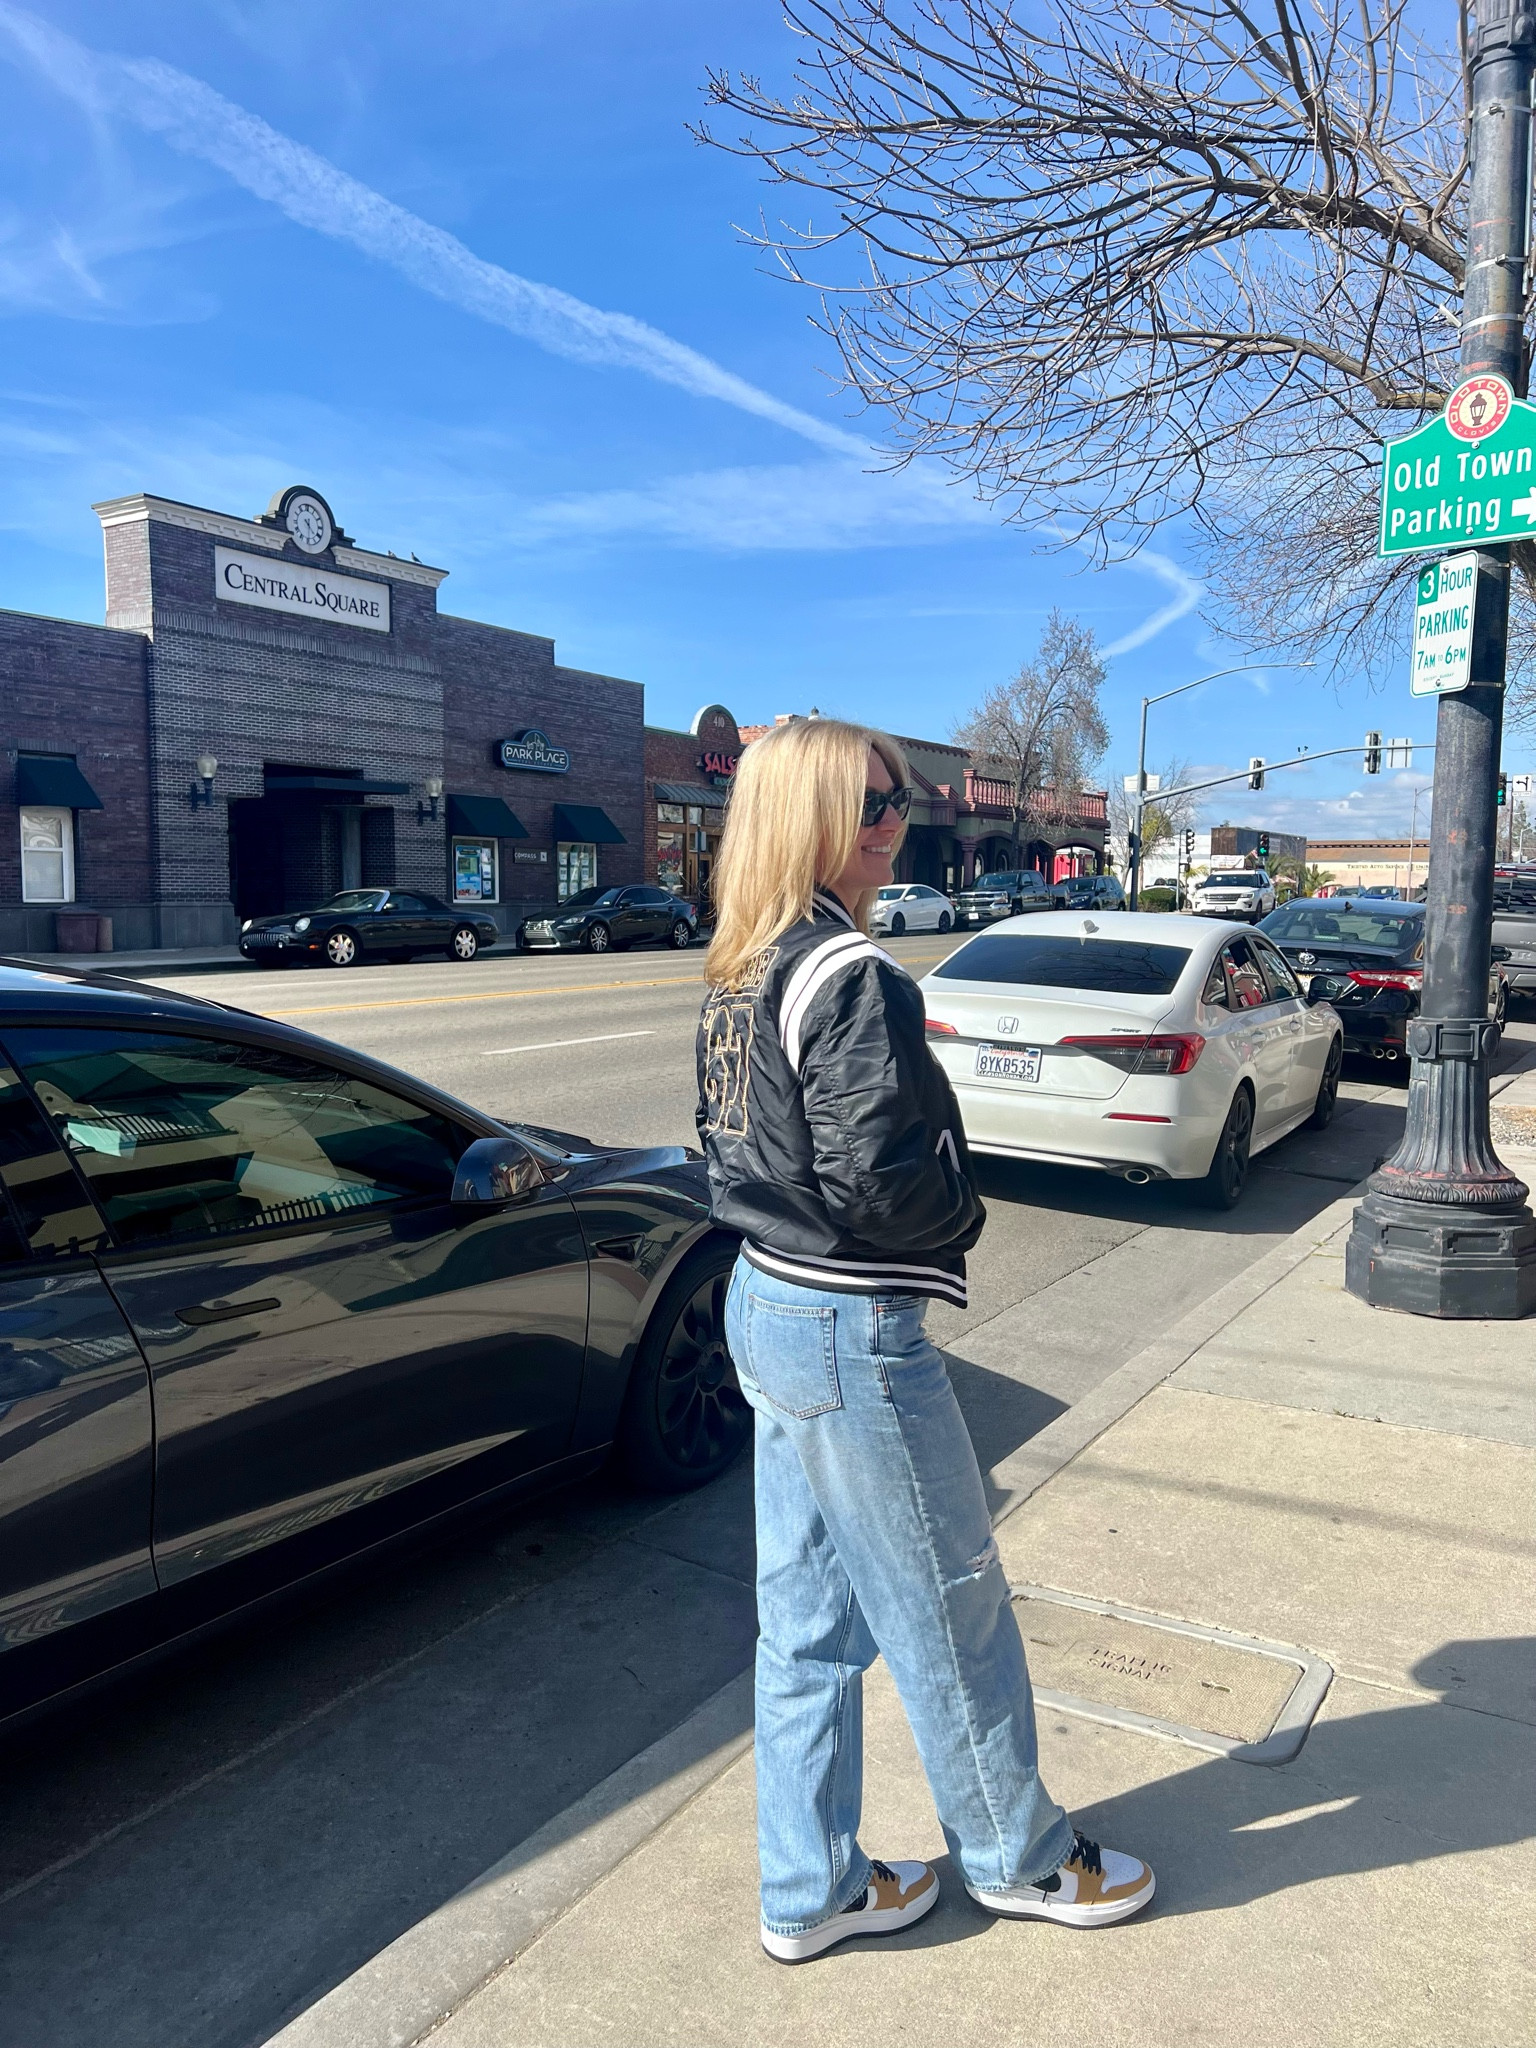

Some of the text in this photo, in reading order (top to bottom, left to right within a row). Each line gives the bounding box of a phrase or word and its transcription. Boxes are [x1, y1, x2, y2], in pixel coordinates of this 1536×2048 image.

[1450, 380, 1507, 424] OLD TOWN
[1457, 420, 1497, 436] CLOVIS
[1394, 447, 1532, 492] Old Town
[1391, 496, 1501, 537] Parking
[224, 563, 380, 618] CENTRAL SQUARE
[1422, 566, 1473, 599] 3 HOUR
[1419, 605, 1469, 639] PARKING
[1417, 651, 1436, 670] 7AM
[1445, 645, 1466, 664] 6PM
[713, 716, 725, 728] 410
[506, 747, 533, 760] PARK
[535, 750, 566, 764] PLACE
[705, 752, 736, 775] SALS
[514, 852, 537, 860] COMPASS
[980, 1055, 1035, 1076] 8YKB535
